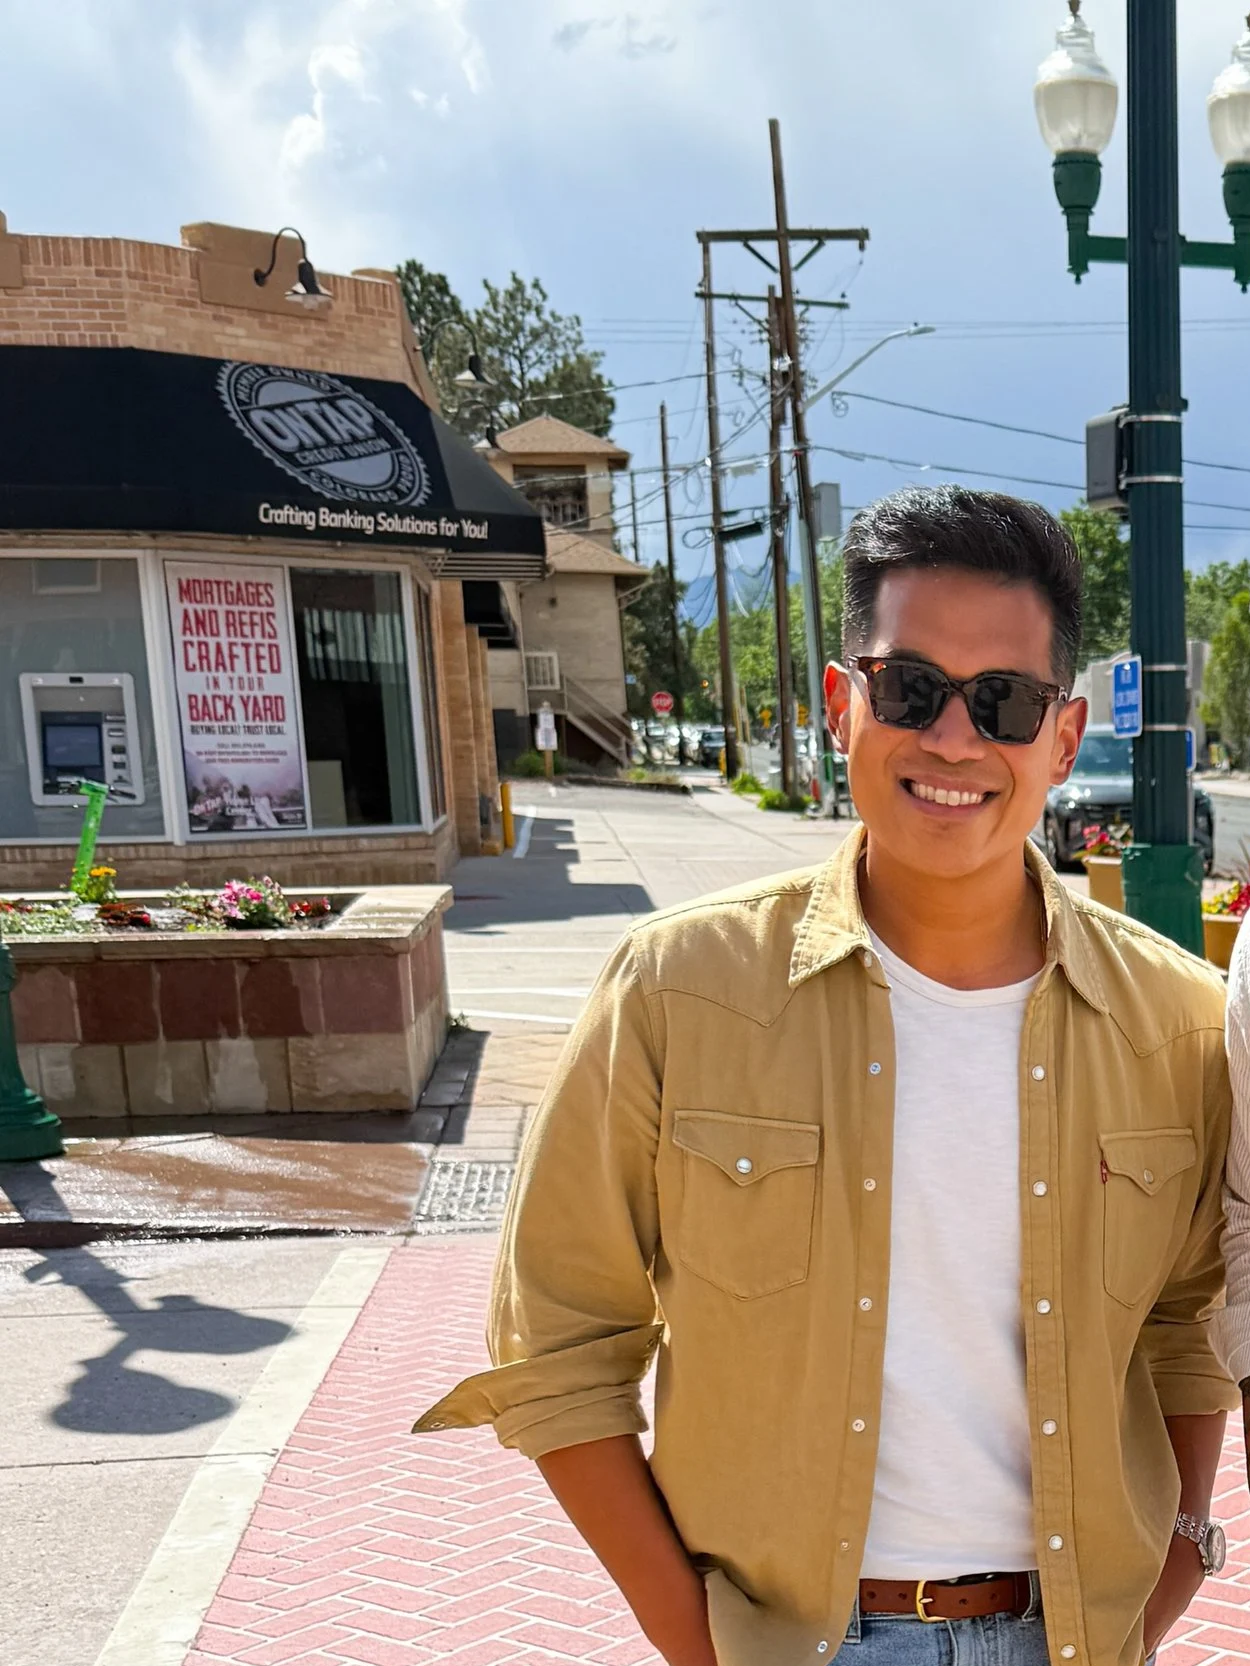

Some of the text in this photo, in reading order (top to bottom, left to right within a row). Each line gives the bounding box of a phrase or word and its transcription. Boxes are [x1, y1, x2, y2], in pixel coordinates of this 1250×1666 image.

[249, 399, 378, 453] ONTAP
[295, 438, 392, 465] CREDIT UNION
[258, 502, 489, 540] Crafting Banking Solutions for You!
[177, 577, 275, 608] MORTGAGES
[182, 608, 278, 640] AND REFIS
[182, 640, 282, 674] CRAFTED
[206, 676, 265, 692] IN YOUR
[187, 694, 286, 723] BACK YARD
